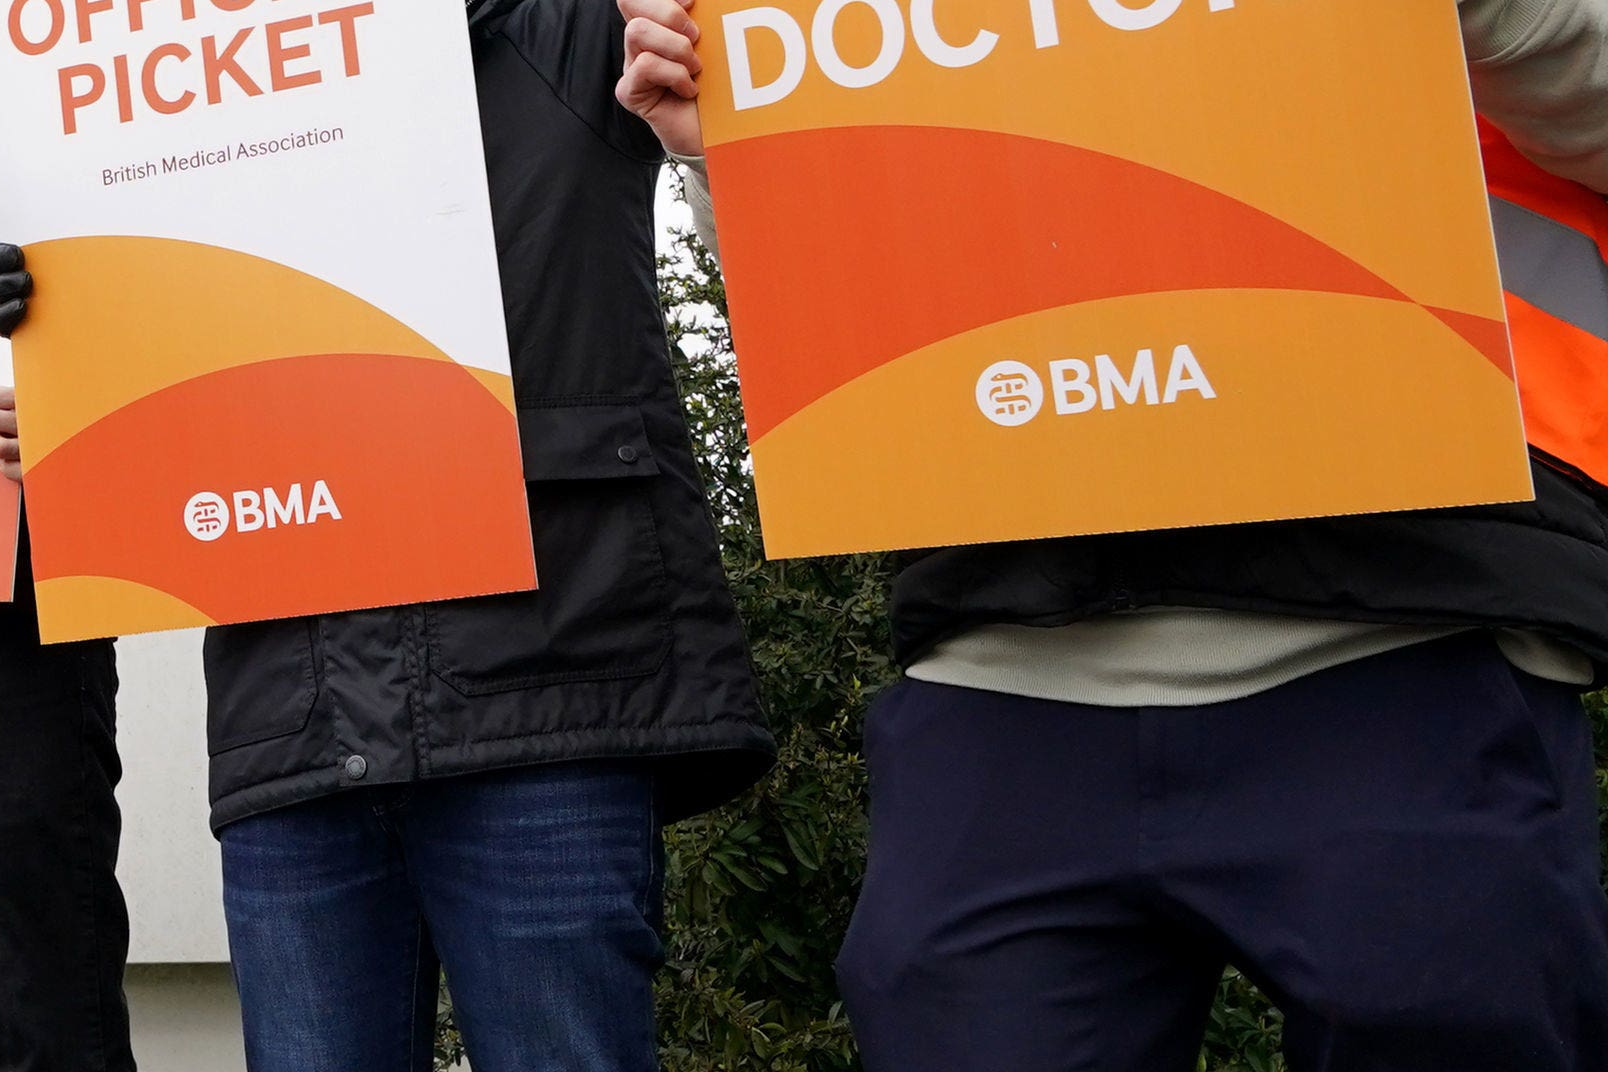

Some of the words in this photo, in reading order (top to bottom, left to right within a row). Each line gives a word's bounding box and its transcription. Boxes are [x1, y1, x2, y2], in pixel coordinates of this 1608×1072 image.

[57, 1, 376, 135] PICKET
[101, 161, 157, 187] British
[162, 145, 232, 175] Medical
[236, 127, 344, 160] Association
[1049, 344, 1217, 415] BMA
[234, 479, 343, 533] BMA
